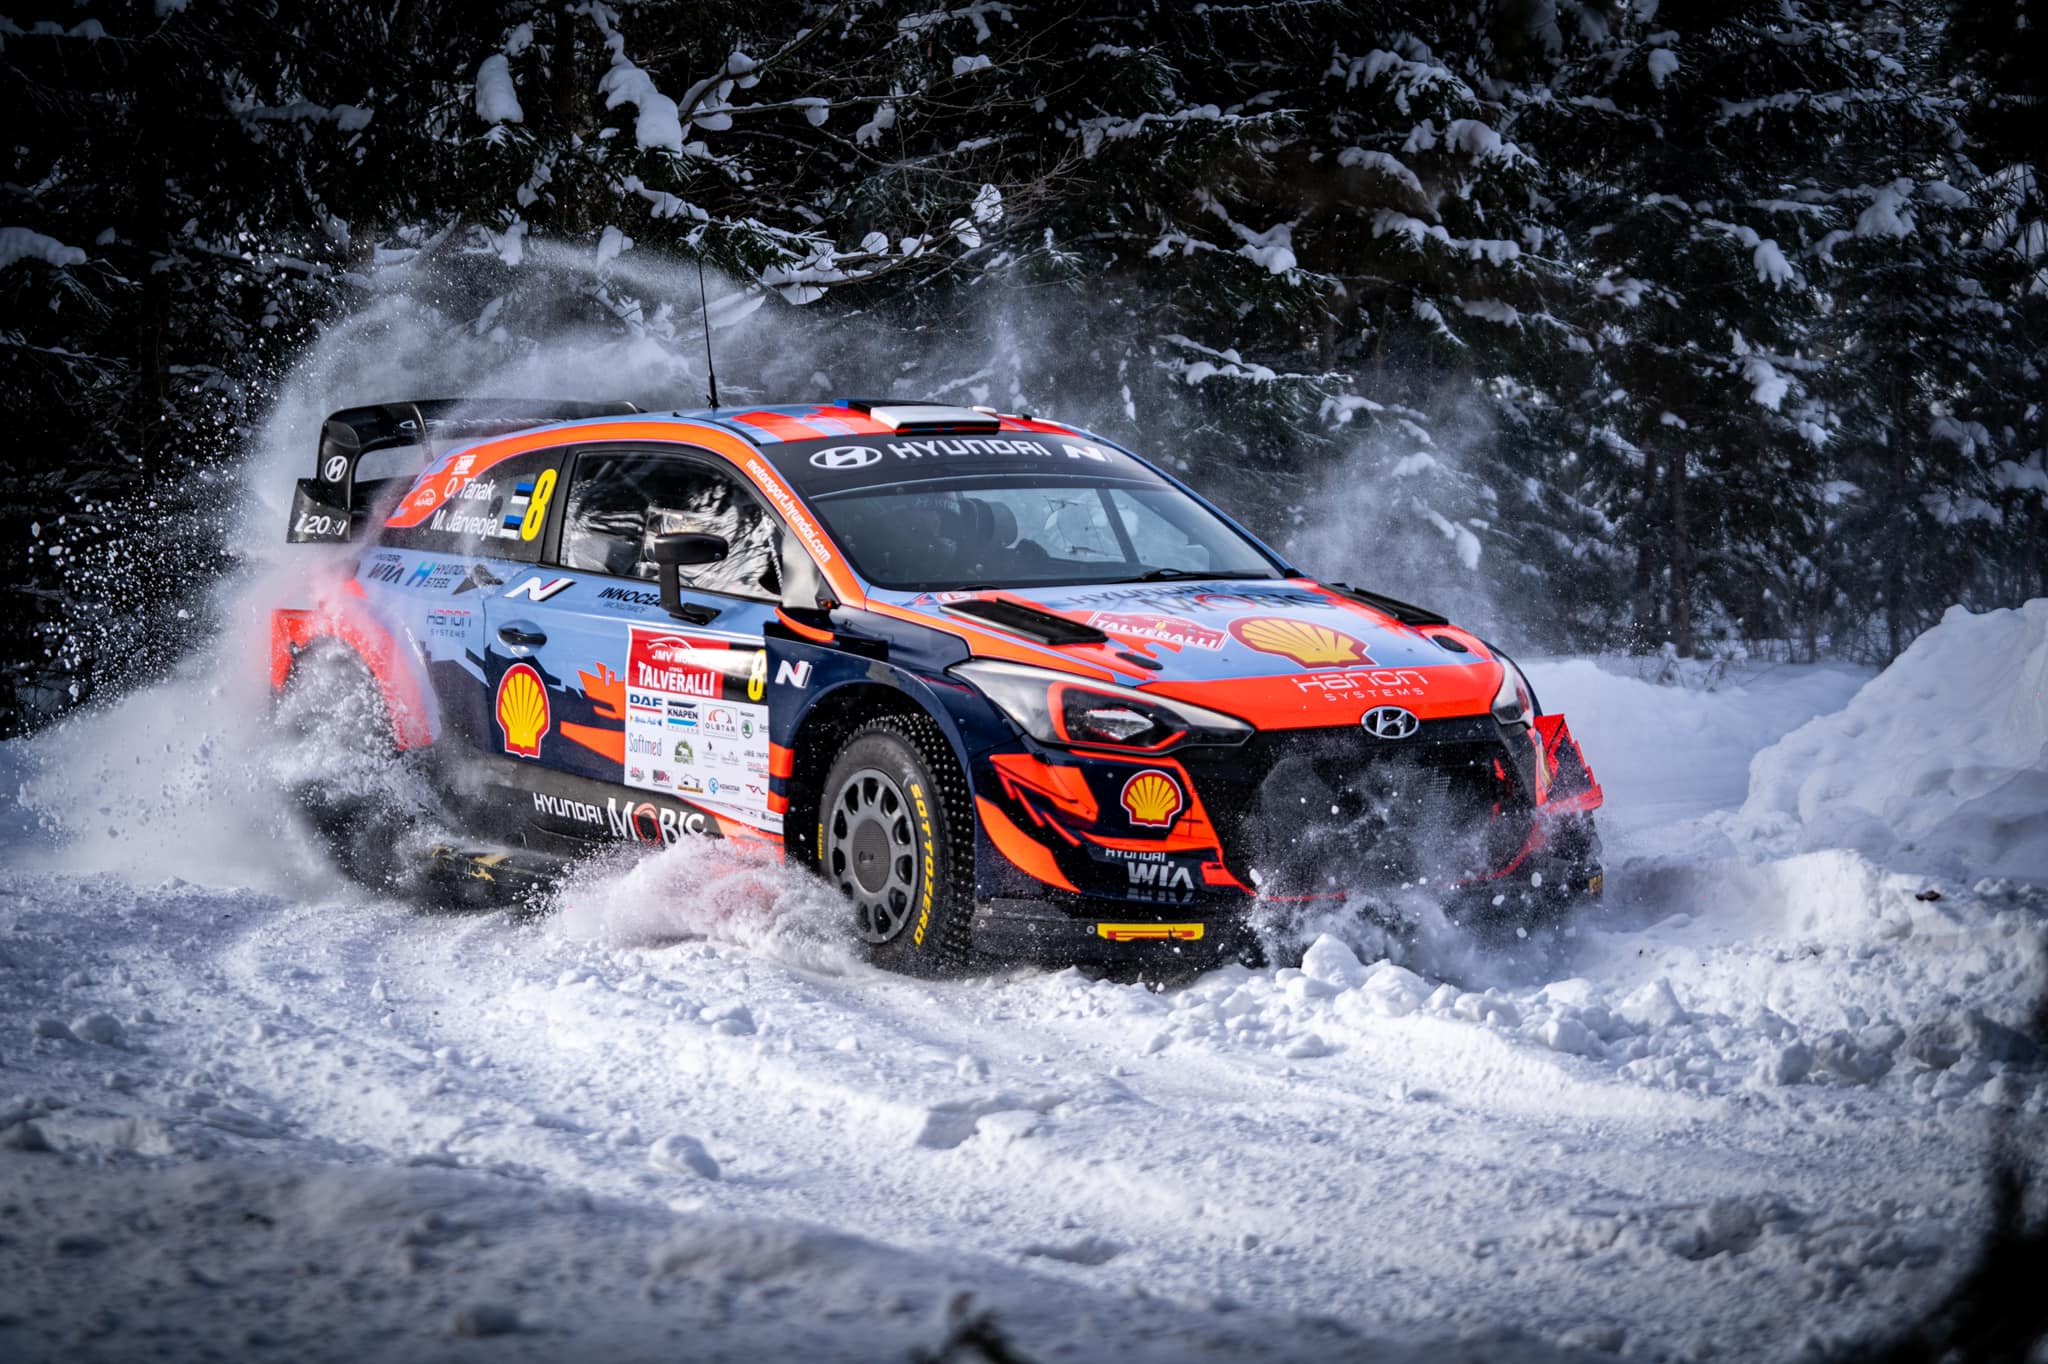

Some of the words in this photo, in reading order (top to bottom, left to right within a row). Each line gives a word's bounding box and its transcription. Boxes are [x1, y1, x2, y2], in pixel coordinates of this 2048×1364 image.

[887, 439, 1051, 459] HYUNDAI
[443, 477, 459, 499] O.
[459, 477, 496, 500] Tänak
[521, 468, 558, 542] 8
[745, 458, 832, 563] motorsport.hyundai.com
[294, 512, 331, 534] i20
[430, 509, 444, 531] M.
[446, 510, 498, 541] Järveoja
[433, 563, 467, 576] HYUNDA
[423, 577, 450, 588] STEEL
[597, 586, 661, 607] INNOCEA
[1066, 585, 1217, 606] HYUNDAI
[1135, 592, 1338, 615] MOBIS
[430, 628, 465, 638] SYSTEMS
[1094, 619, 1217, 649] TALVERALLI
[651, 649, 673, 663] JMV
[637, 660, 715, 696] TALVERALLI
[747, 648, 767, 702] 8
[629, 693, 663, 707] DAF
[1324, 687, 1425, 702] SYSTEMS
[667, 707, 699, 720] KNAPEN
[628, 732, 663, 757] Softmed
[533, 791, 604, 825] HYUNDAI
[910, 783, 935, 945] SOTTOZERO
[1105, 847, 1166, 863] HYUNDAI
[1127, 860, 1195, 890] WIA
